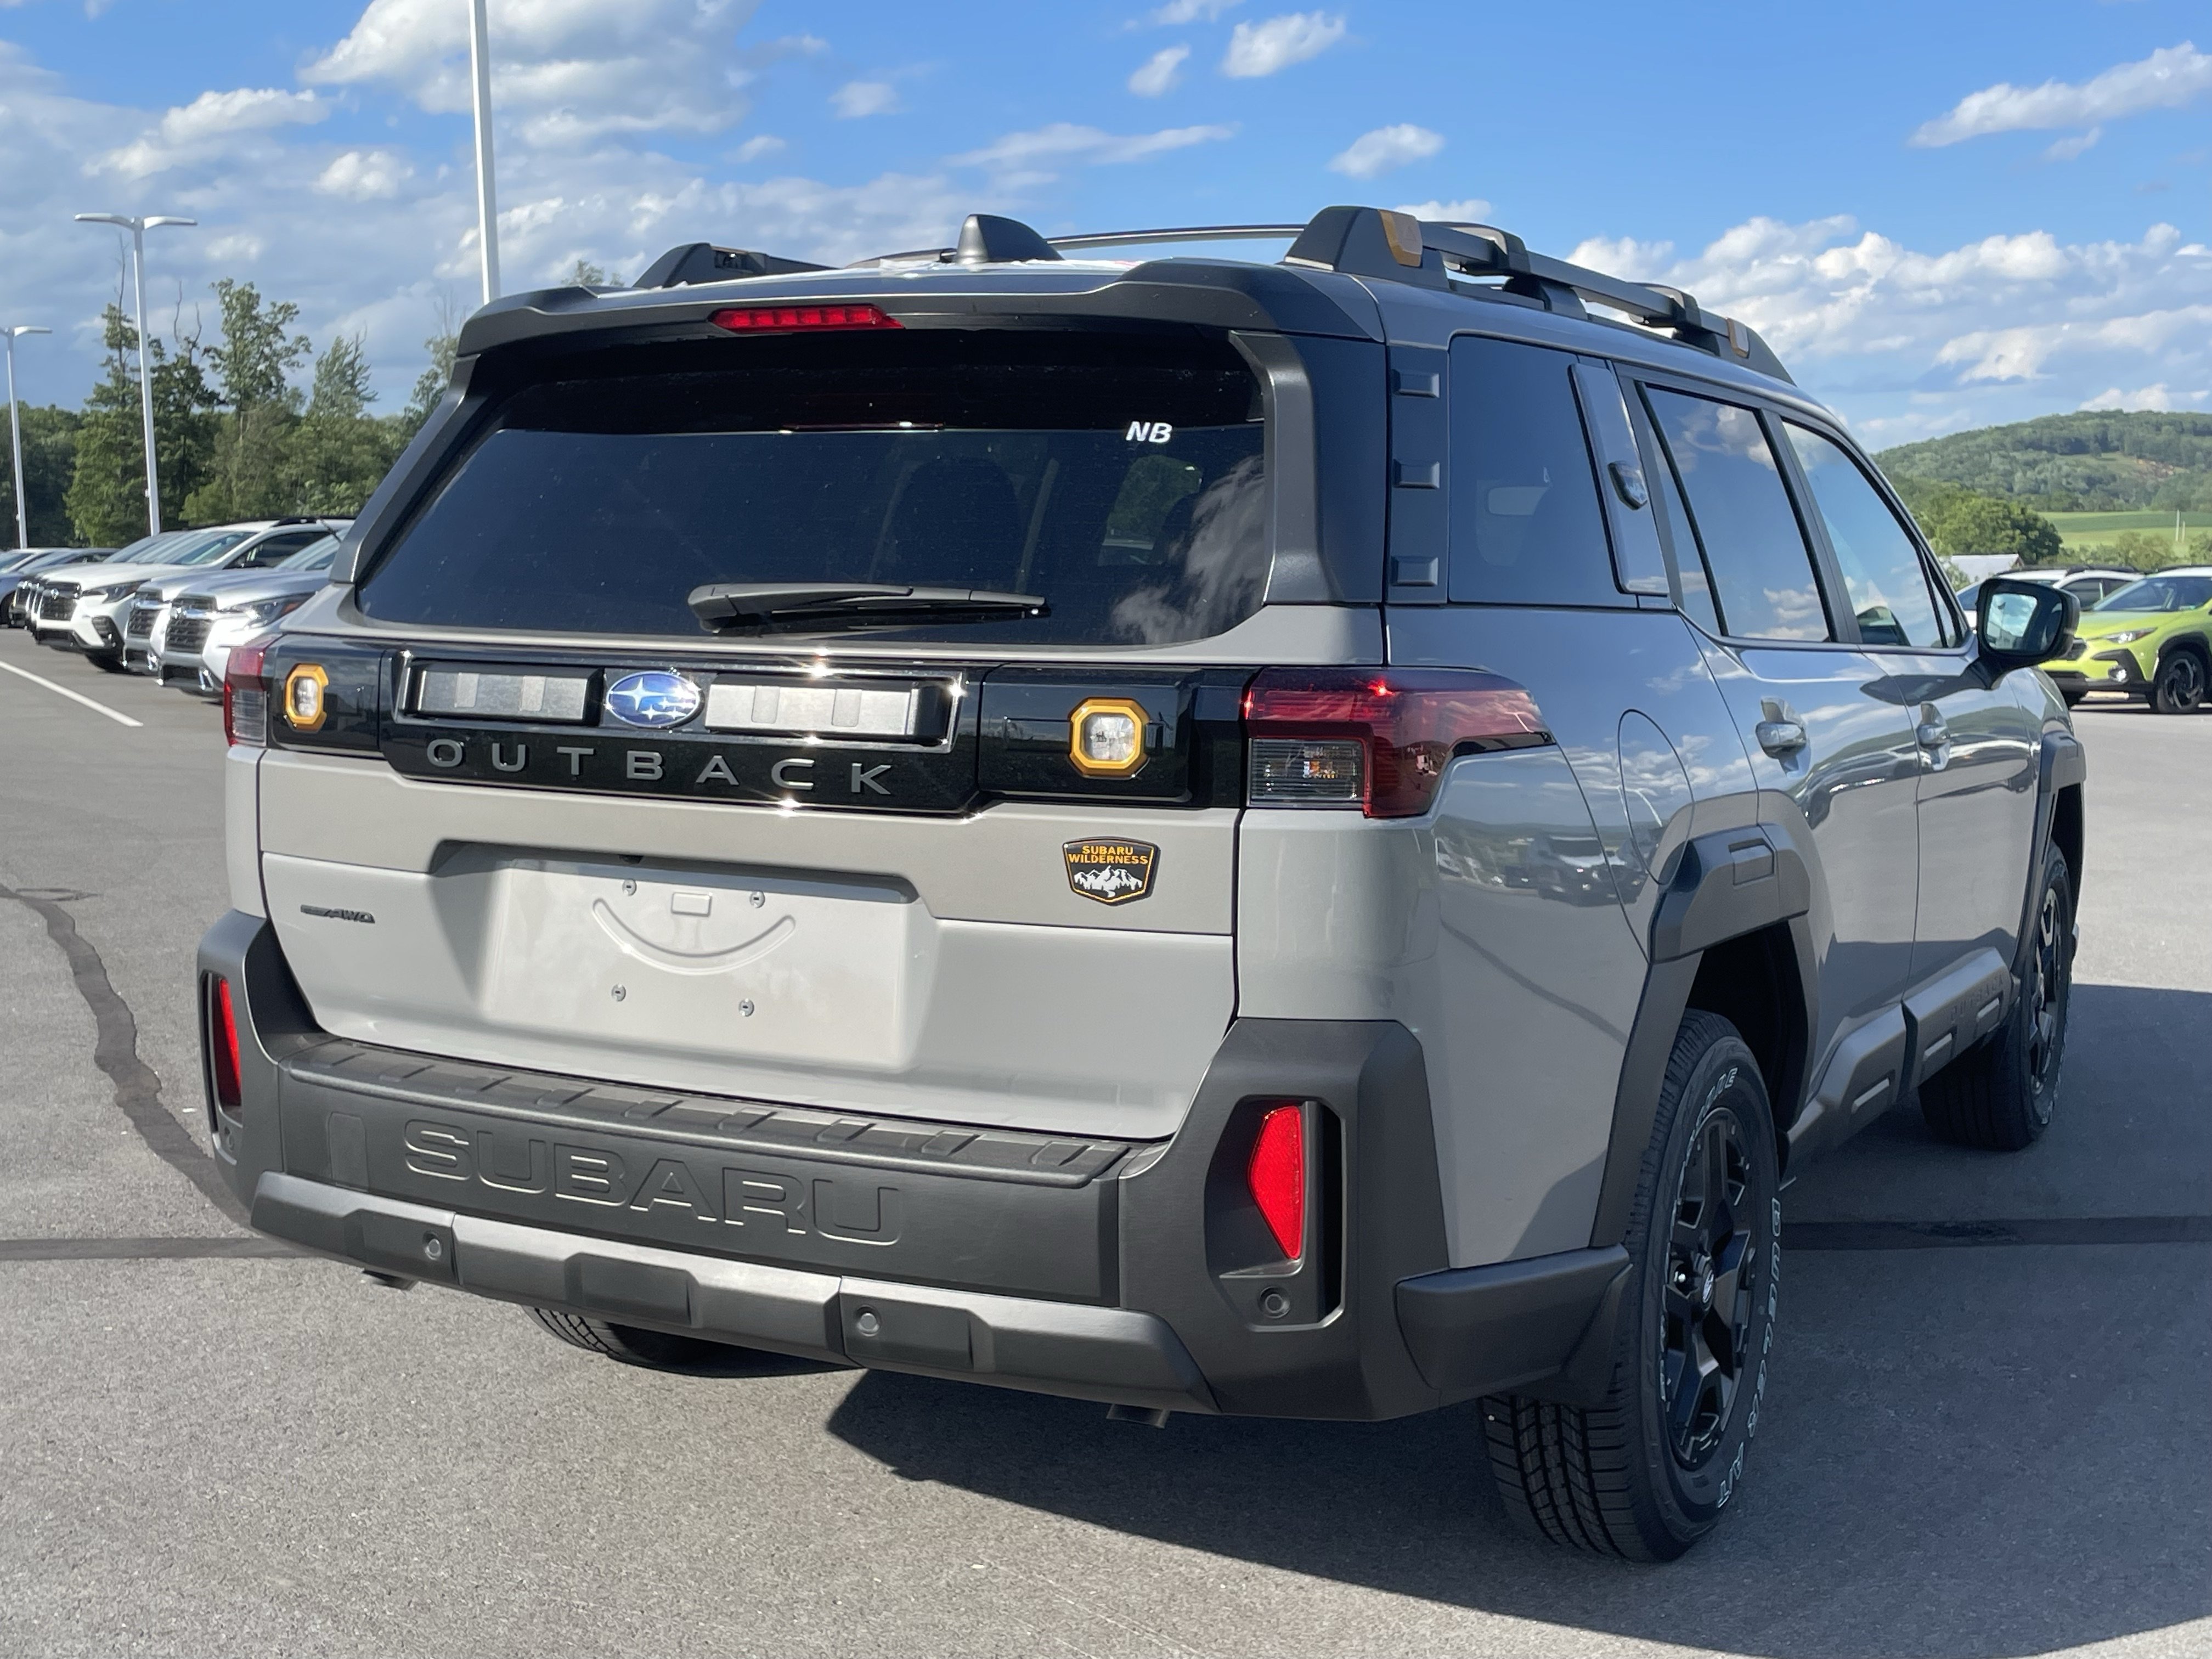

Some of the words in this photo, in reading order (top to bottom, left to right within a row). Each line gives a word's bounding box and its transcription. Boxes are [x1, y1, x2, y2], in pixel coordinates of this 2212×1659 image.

[1126, 421, 1173, 443] NB
[426, 738, 893, 795] OUTBACK
[1068, 854, 1149, 865] WILDERNESS
[1081, 845, 1134, 855] SUBARU
[326, 908, 376, 924] AWD
[404, 1119, 904, 1246] SUBARU
